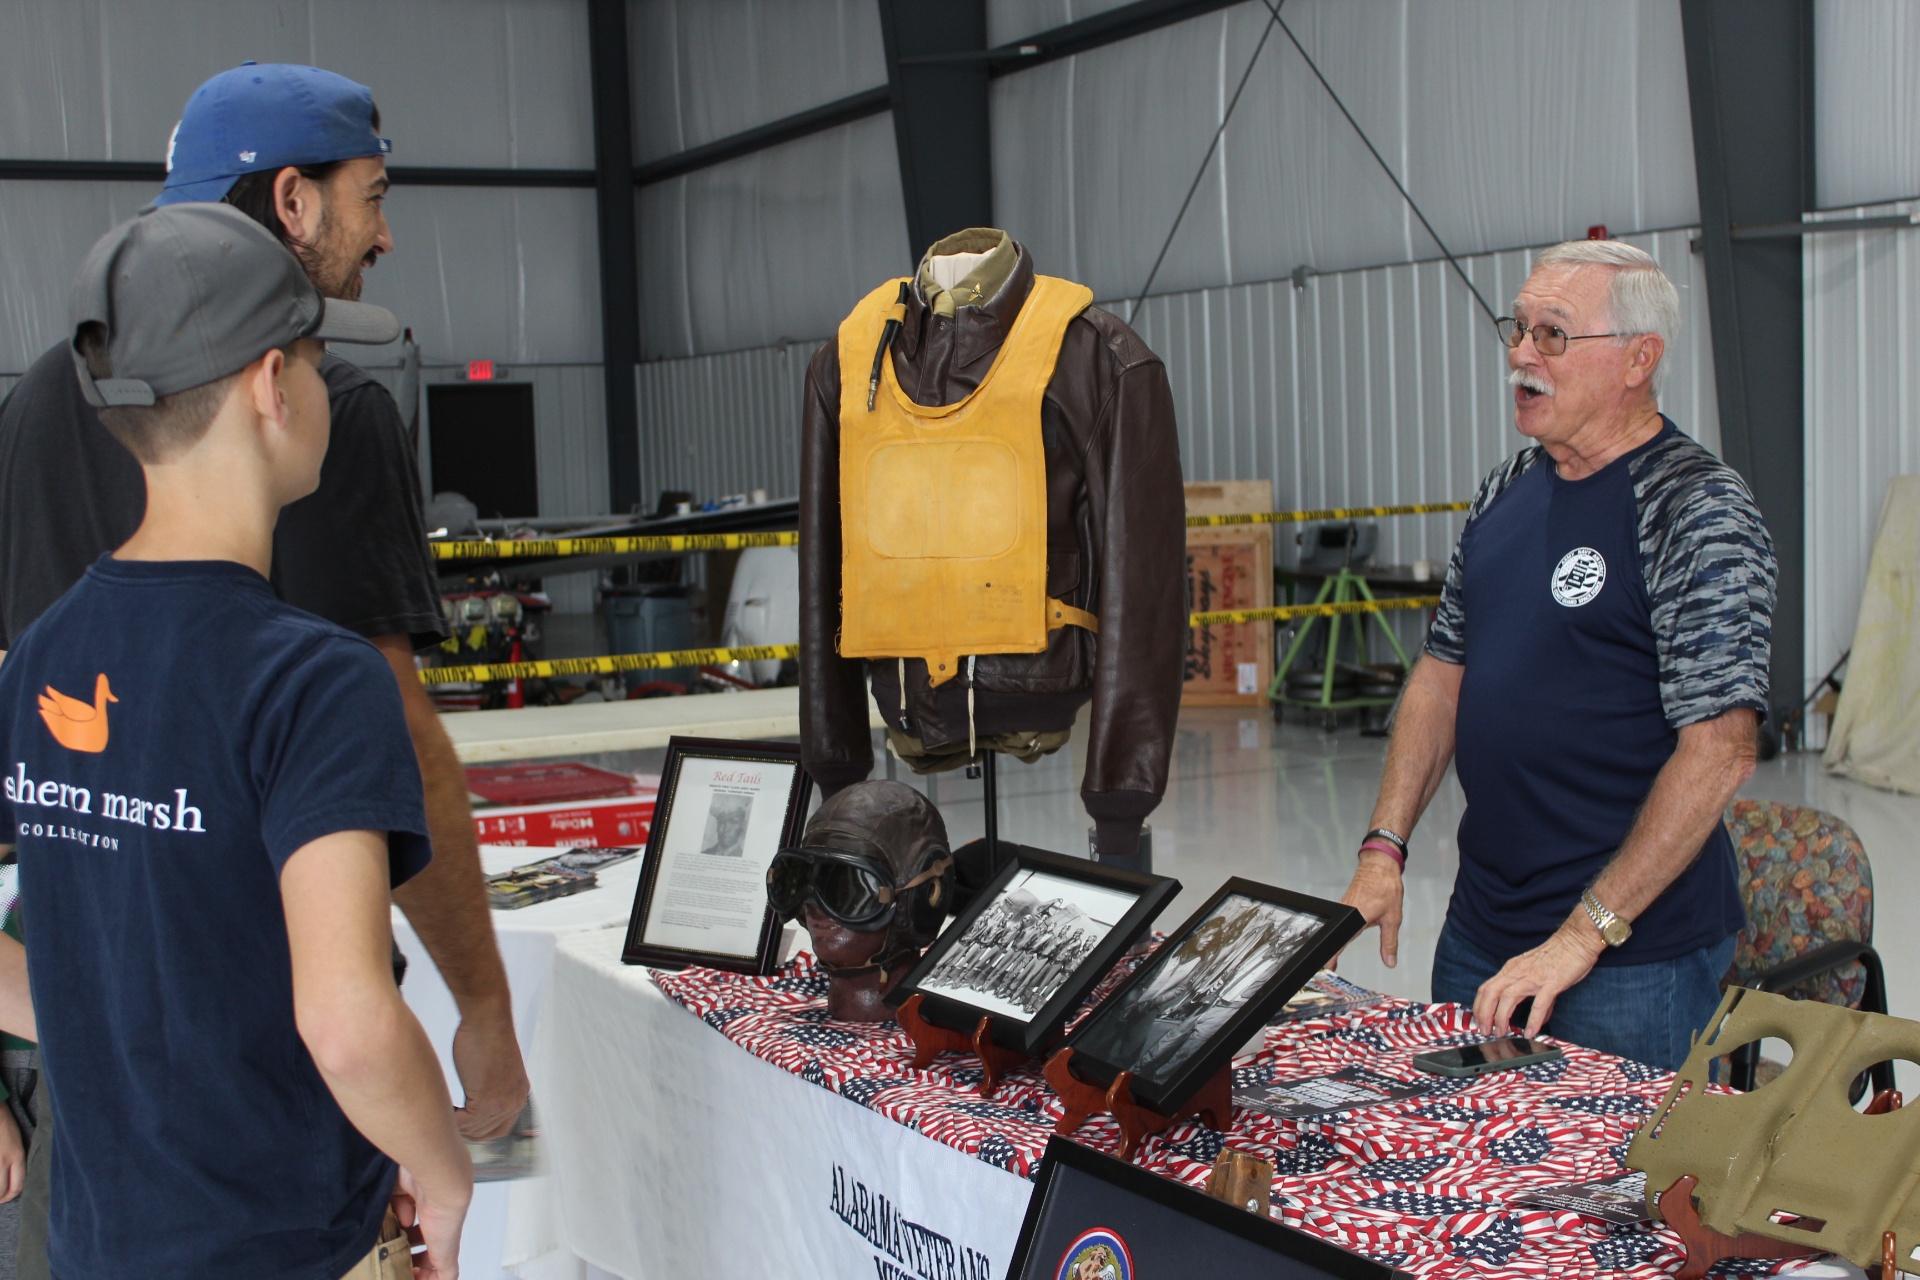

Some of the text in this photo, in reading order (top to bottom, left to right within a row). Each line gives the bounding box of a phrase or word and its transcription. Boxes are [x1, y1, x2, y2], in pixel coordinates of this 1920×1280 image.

[453, 541, 500, 558] CAUTION
[512, 540, 559, 556] CAUTION
[571, 539, 617, 554] CAUTION
[628, 536, 671, 552] CAUTION
[684, 534, 727, 550] CAUTION
[550, 658, 600, 676] CAUTION
[612, 653, 660, 670] CAUTION
[424, 667, 475, 684] CAUTION
[487, 663, 539, 680] CAUTION
[714, 771, 762, 784] Red Tails
[101, 789, 206, 832] marsh
[19, 822, 119, 850] COLLECTION
[830, 1161, 990, 1280] ALABAMA VETERANS
